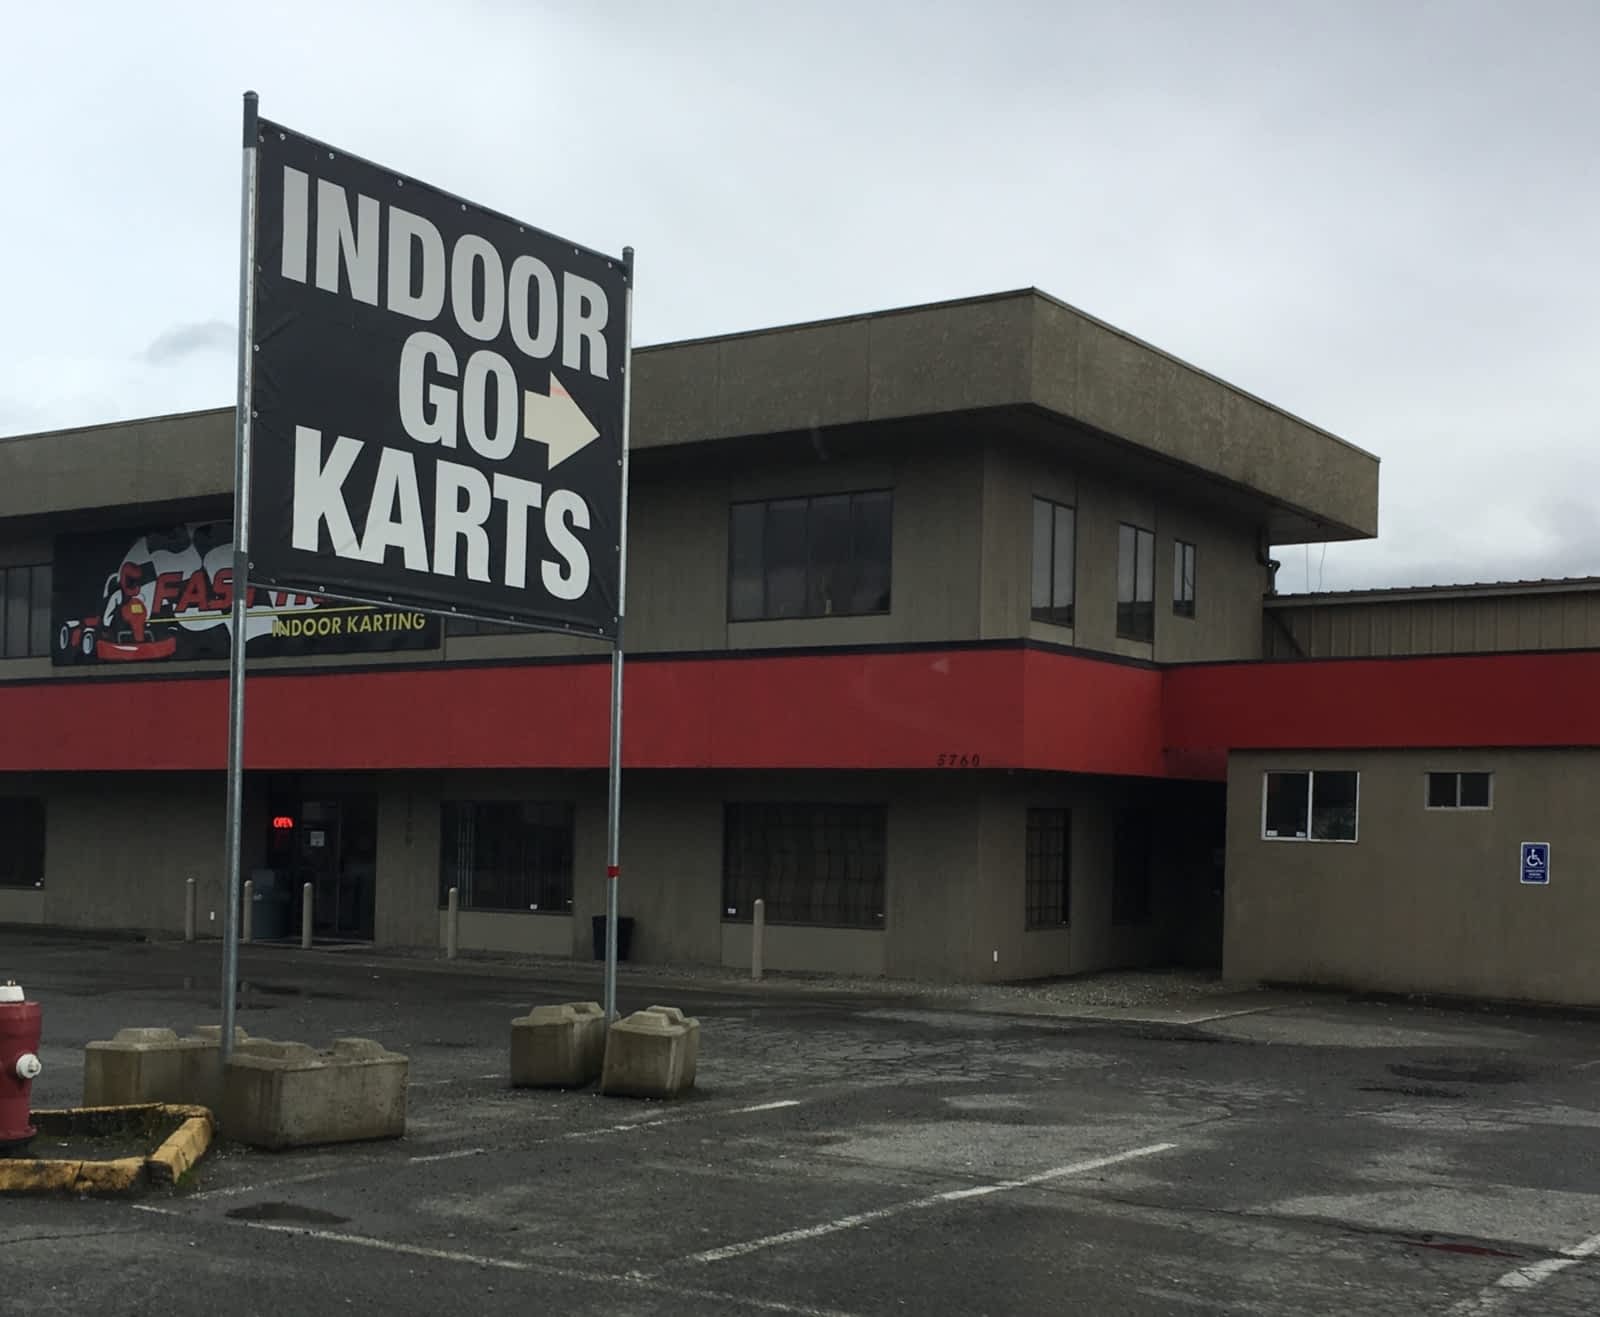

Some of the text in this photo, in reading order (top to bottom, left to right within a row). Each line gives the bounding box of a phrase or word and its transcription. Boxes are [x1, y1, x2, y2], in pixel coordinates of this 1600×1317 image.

[281, 165, 609, 380] INDOOR
[399, 331, 519, 460] GO
[292, 424, 591, 601] KARTS
[271, 612, 427, 638] INDOOR KARTING
[936, 753, 981, 767] 5760
